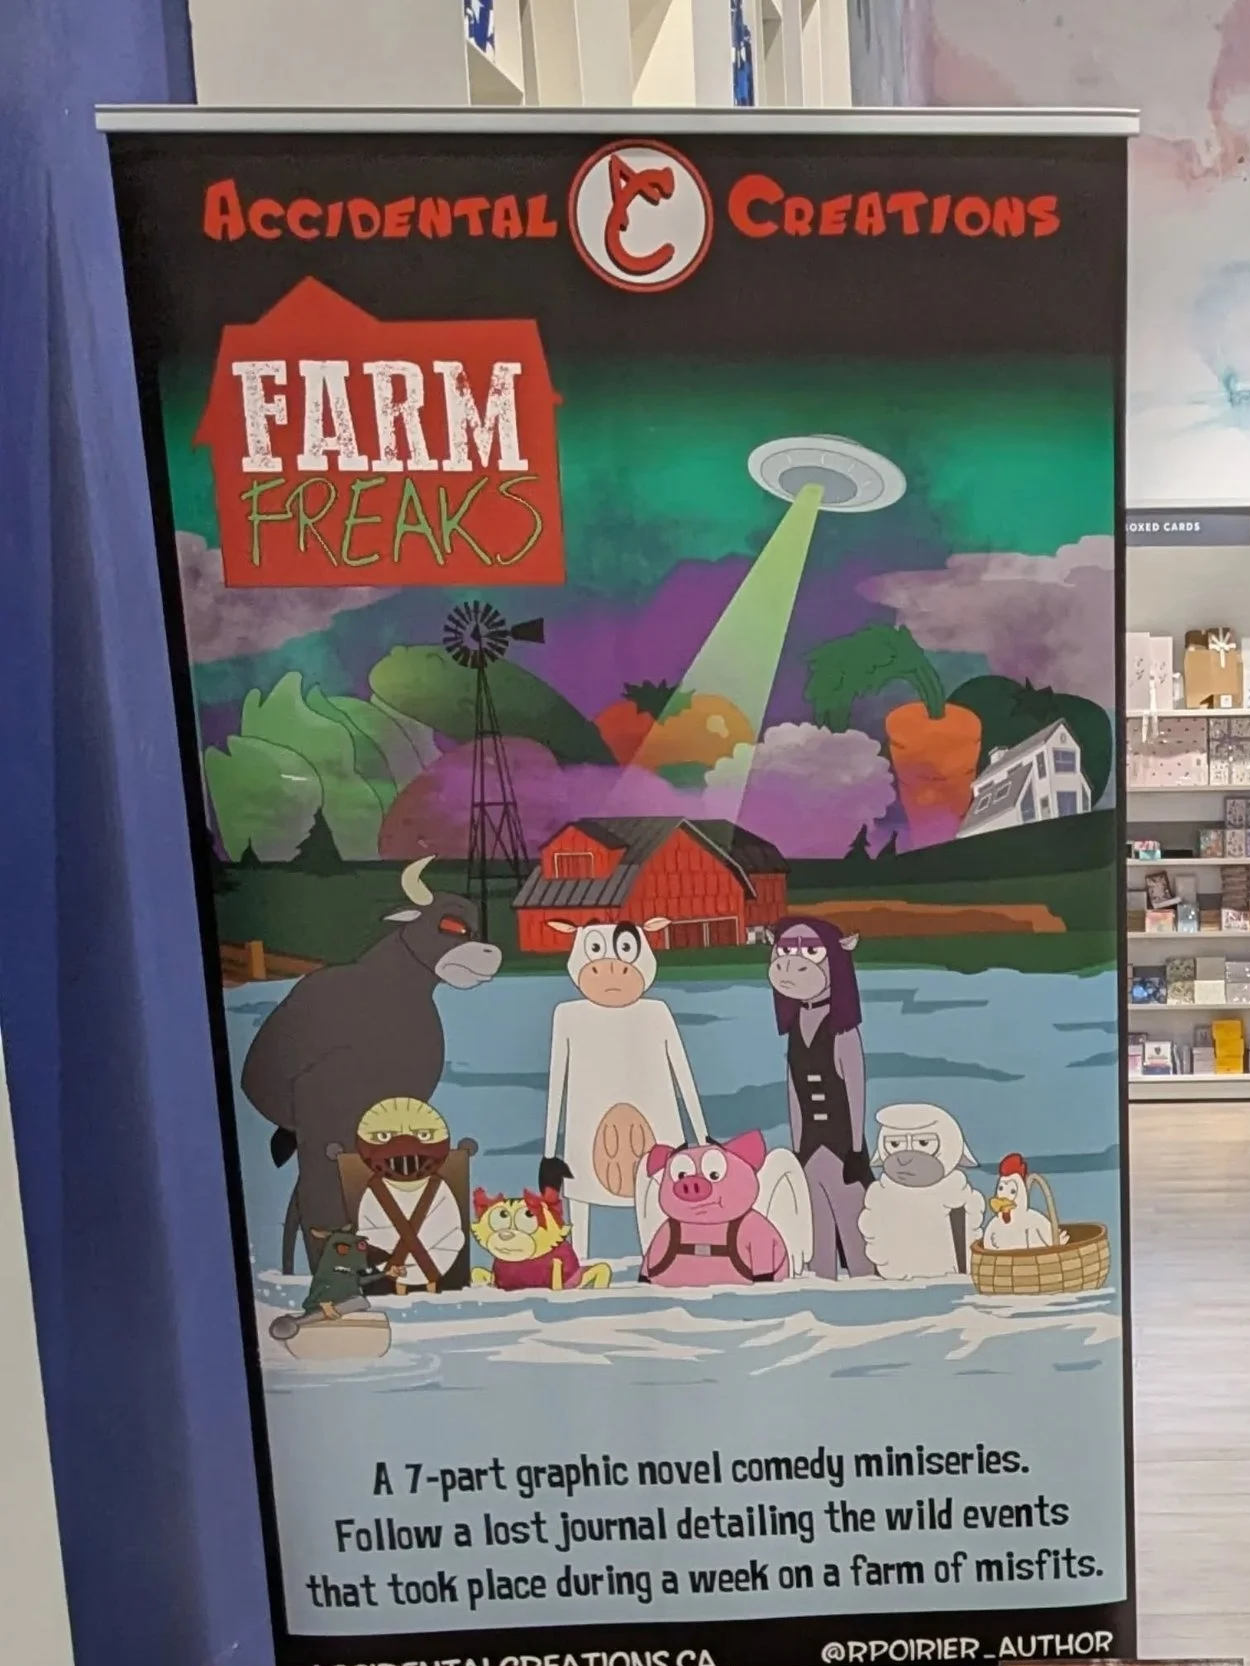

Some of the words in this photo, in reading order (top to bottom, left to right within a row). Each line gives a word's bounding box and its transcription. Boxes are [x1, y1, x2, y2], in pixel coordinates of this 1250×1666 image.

[204, 178, 557, 241] ACCIDENTAL
[728, 173, 1060, 239] CREATIONS
[232, 358, 527, 474] FARM
[240, 475, 545, 570] FREAKS
[1164, 522, 1201, 532] CARDS
[373, 1462, 394, 1496] A
[405, 1457, 507, 1502] 7-part
[516, 1454, 629, 1499] graphic
[638, 1450, 722, 1486] novel
[732, 1446, 845, 1488] comedy
[855, 1443, 1030, 1478] miniseries.
[335, 1517, 443, 1553] Follow
[454, 1522, 473, 1548] a
[484, 1511, 549, 1546] lost
[555, 1508, 667, 1553] journal
[676, 1503, 815, 1544] detailing
[824, 1500, 876, 1534] the
[885, 1497, 953, 1531] wild
[963, 1494, 1070, 1529] events
[306, 1573, 378, 1608] that
[387, 1570, 459, 1605] took
[467, 1567, 547, 1611] place
[556, 1564, 653, 1605] during
[661, 1569, 679, 1596] a
[689, 1559, 769, 1594] week
[778, 1564, 814, 1591] on
[823, 1561, 841, 1588] a
[850, 1553, 925, 1587] farm
[934, 1550, 967, 1584] of
[975, 1547, 1104, 1581] misfits.
[821, 1630, 1114, 1664] @RPOIRIER_AUTHOR
